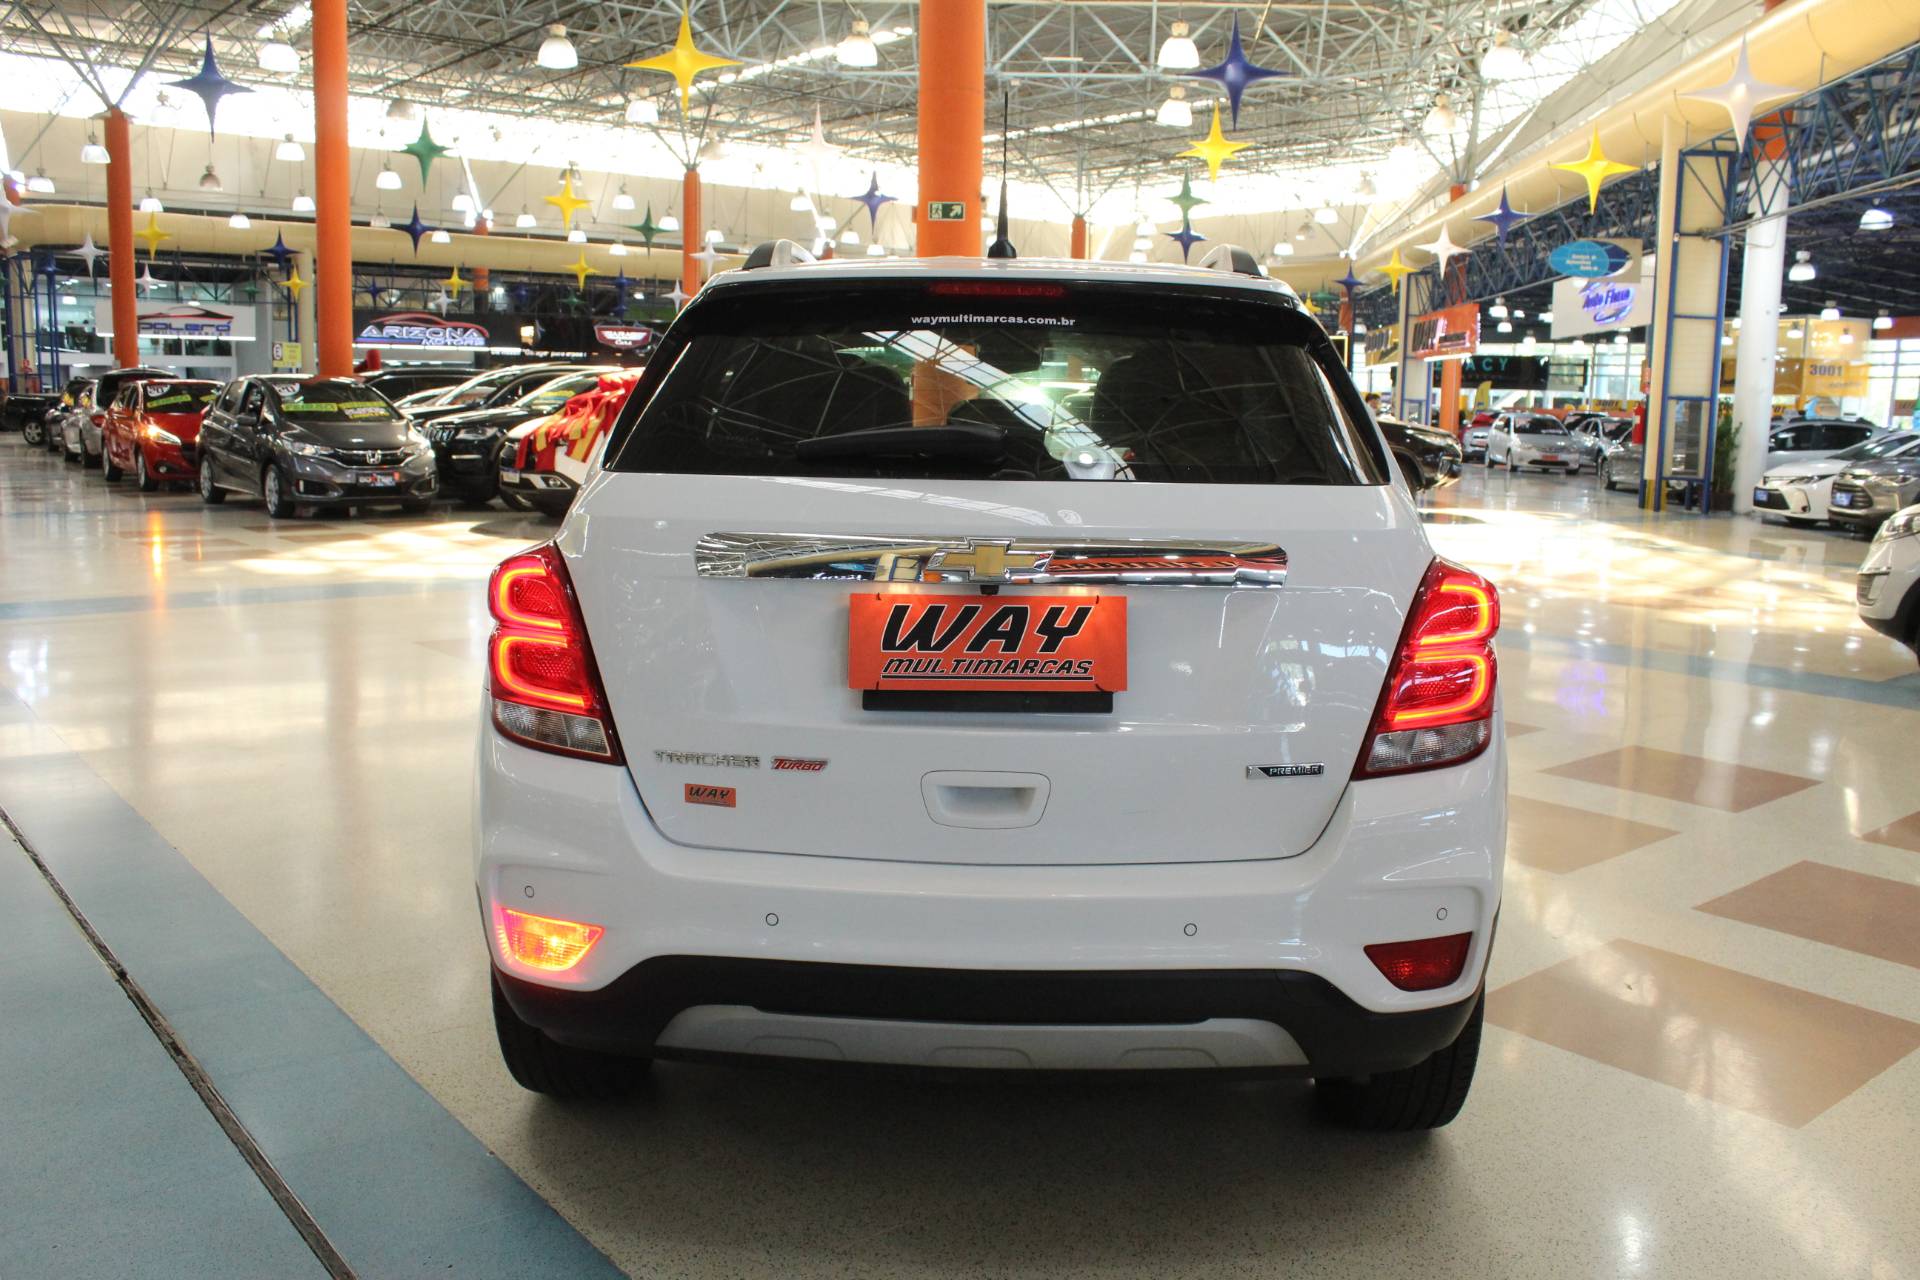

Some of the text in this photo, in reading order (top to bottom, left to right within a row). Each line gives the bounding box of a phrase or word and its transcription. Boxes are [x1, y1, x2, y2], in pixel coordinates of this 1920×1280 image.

[911, 314, 1076, 326] waymultimarcas.com.br
[360, 325, 485, 340] ARIZONA
[881, 603, 1094, 654] WAY
[882, 657, 1094, 675] MULTIMARCAS
[654, 750, 828, 772] TRACKER TURBO
[1269, 765, 1321, 776] PREMIER
[688, 786, 731, 800] WAY
